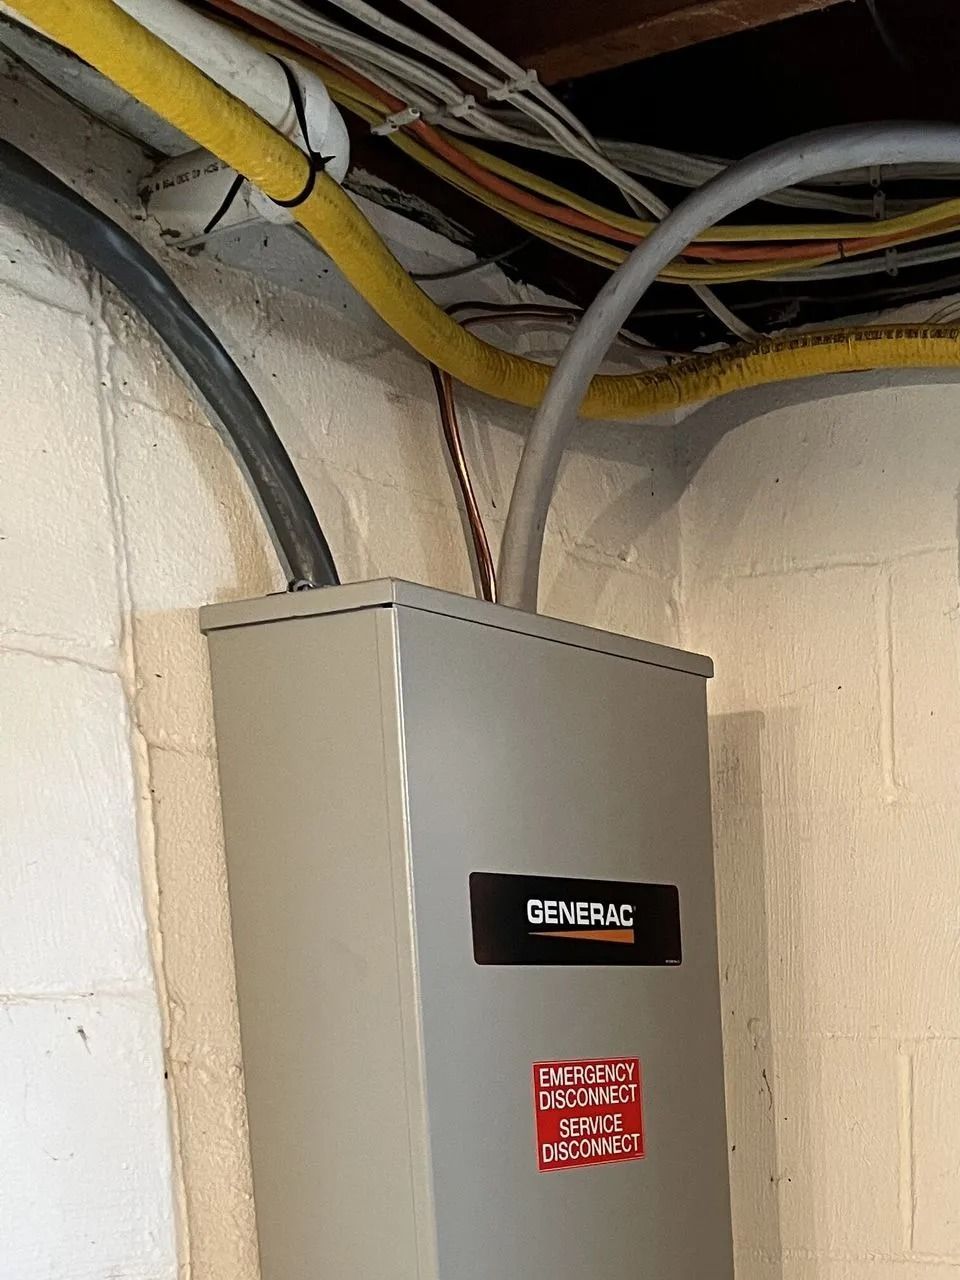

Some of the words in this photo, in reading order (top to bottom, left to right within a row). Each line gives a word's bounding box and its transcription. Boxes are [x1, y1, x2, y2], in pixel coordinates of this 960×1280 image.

[526, 899, 634, 927] GENERAC
[539, 1062, 635, 1088] EMERGENCY
[539, 1083, 638, 1111] DISCONNECT
[559, 1113, 623, 1138] SERVICE
[542, 1133, 641, 1163] DISCONNECT
